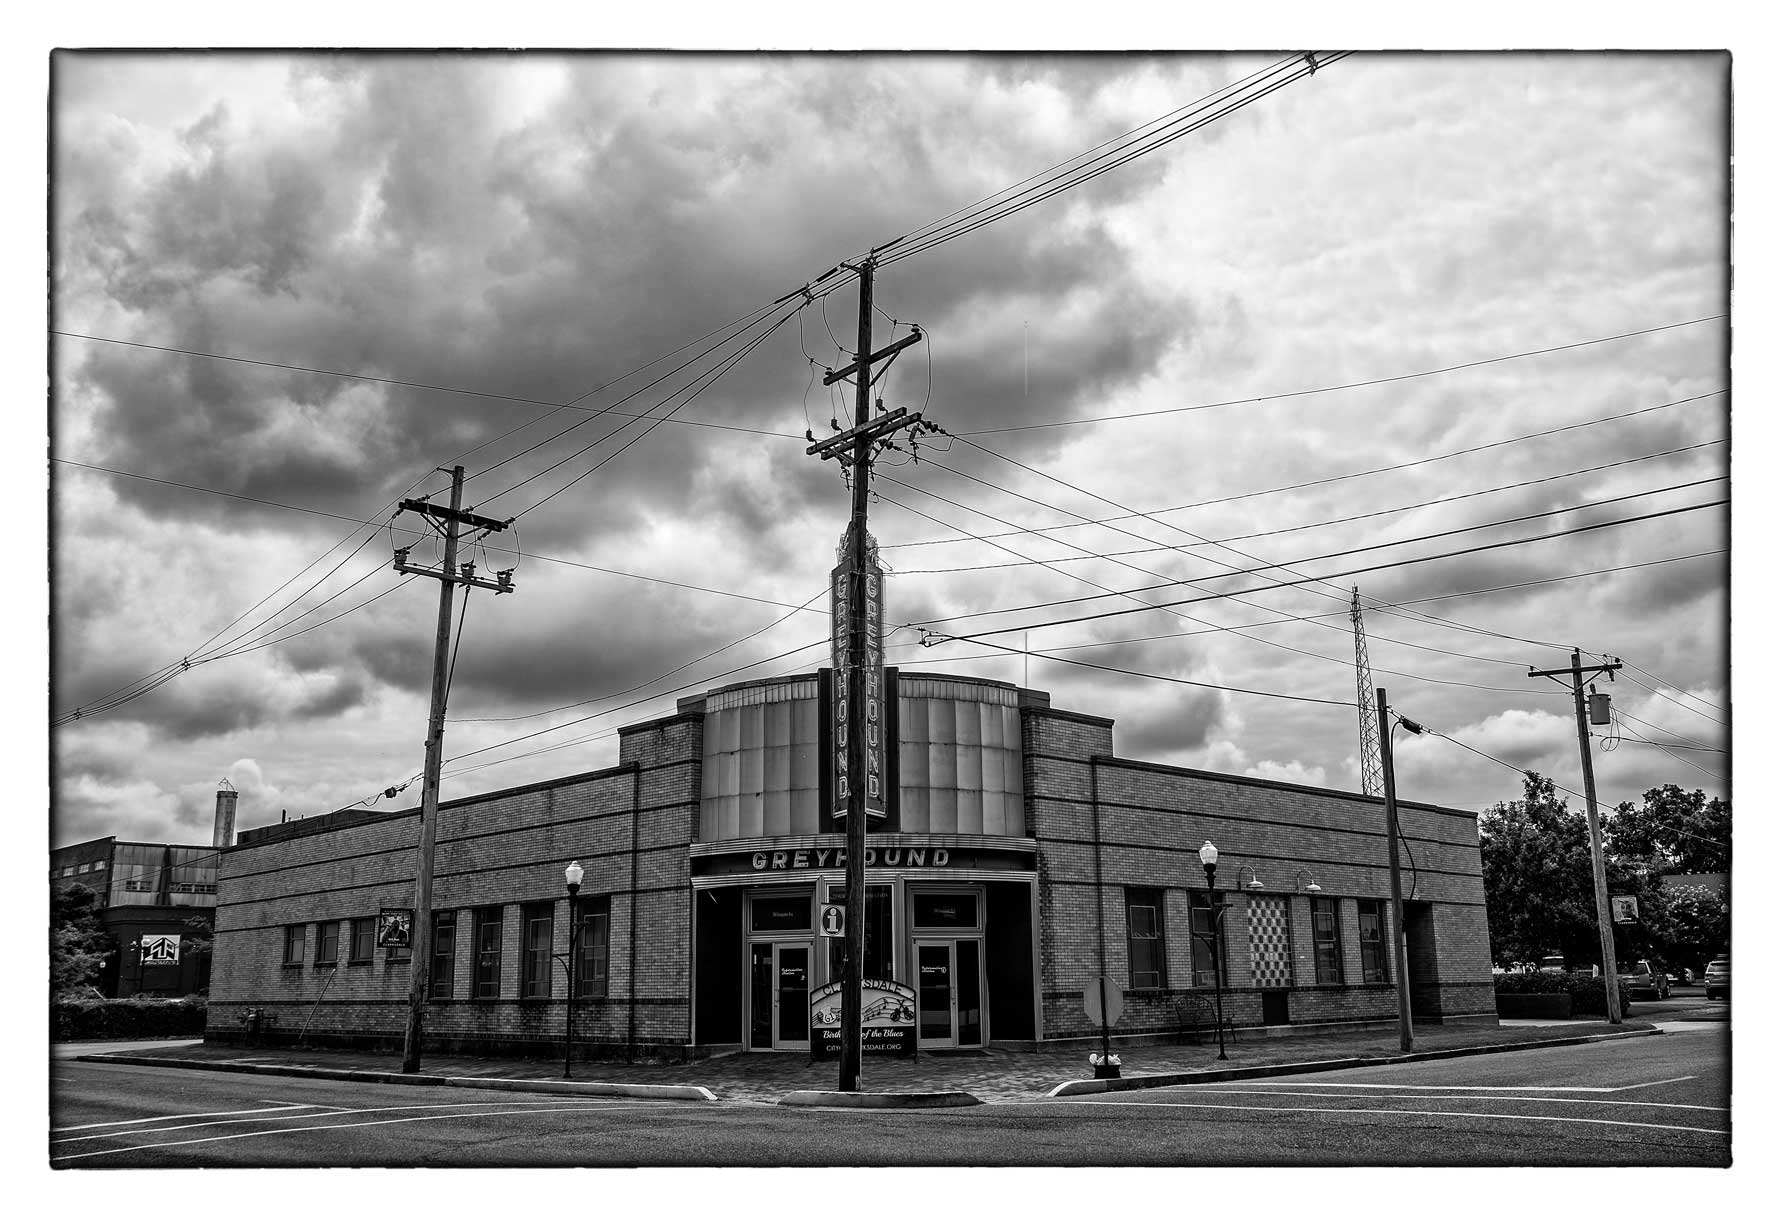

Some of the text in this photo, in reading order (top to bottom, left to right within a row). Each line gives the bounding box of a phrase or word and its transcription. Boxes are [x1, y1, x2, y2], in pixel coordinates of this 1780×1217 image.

[837, 574, 849, 800] GREYHOUND
[866, 574, 879, 799] GREYHOUND
[823, 979, 902, 996] CLSDALE
[861, 1030, 871, 1040] of
[871, 1029, 882, 1038] the
[883, 1029, 904, 1038] Blues
